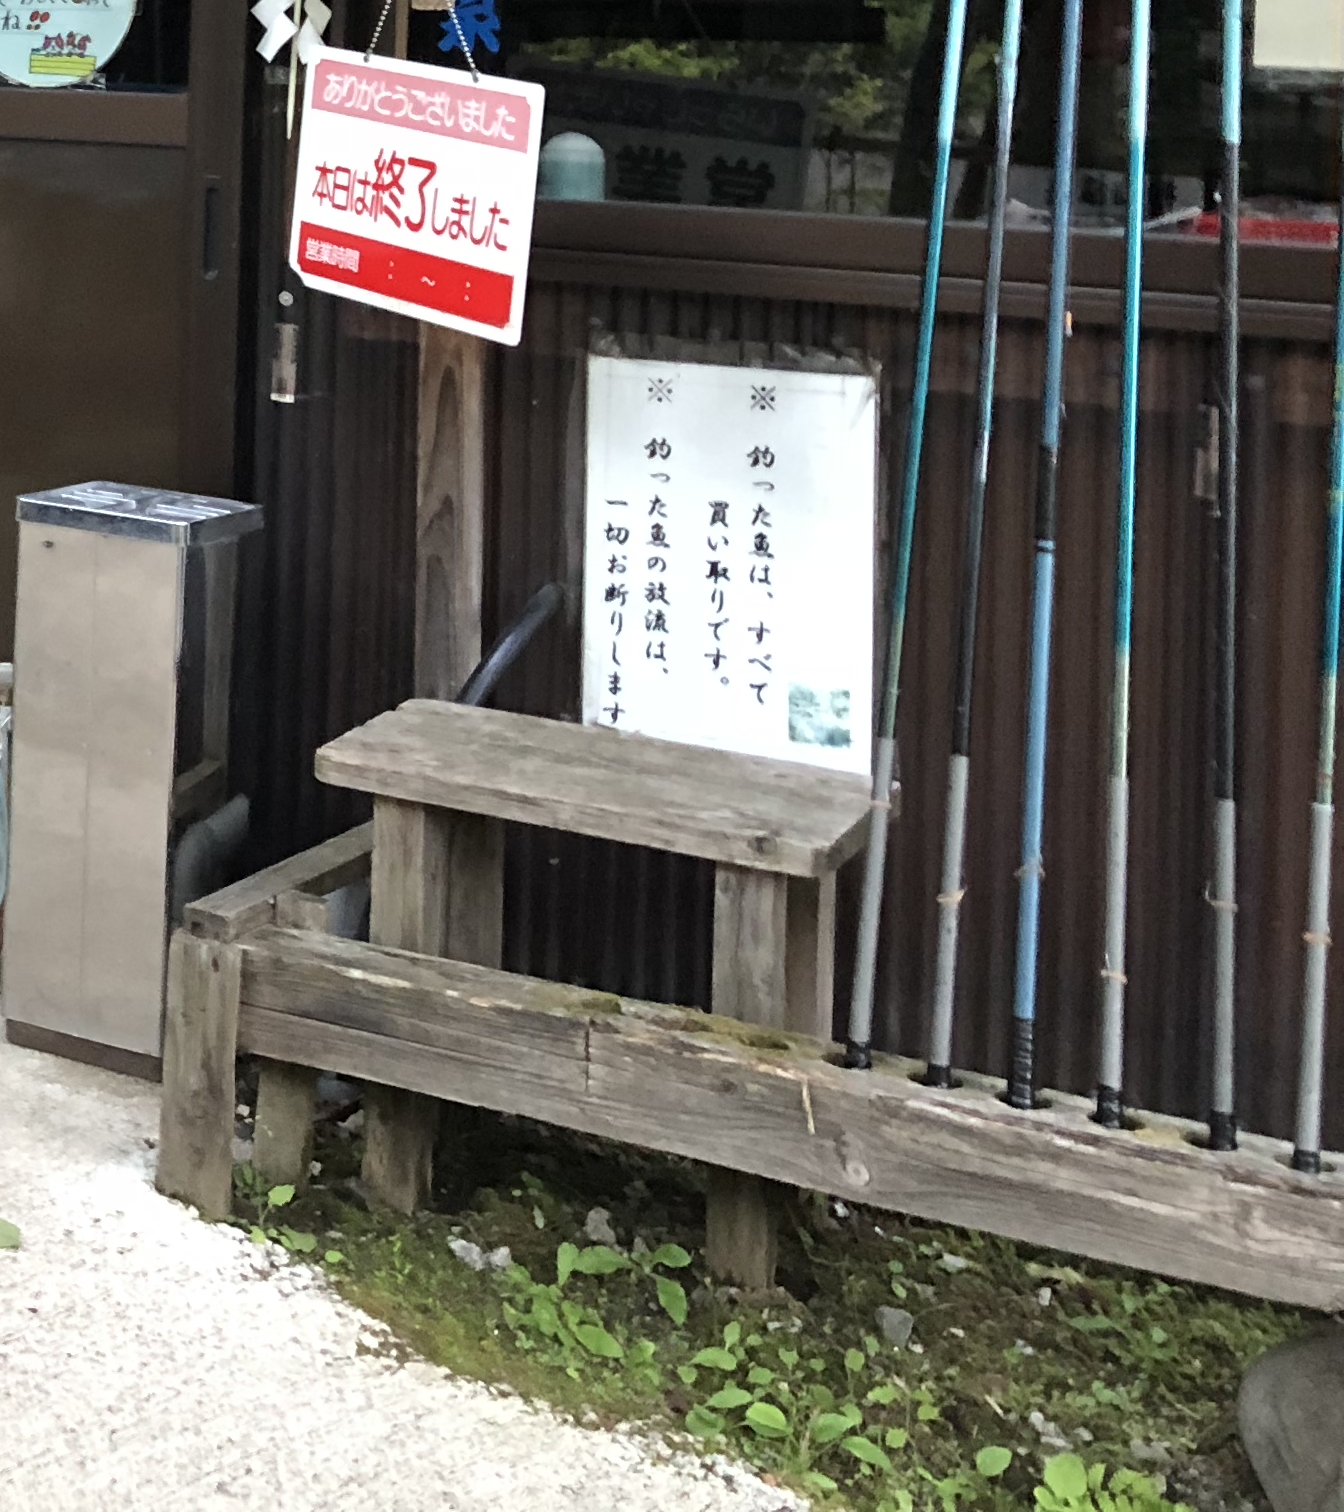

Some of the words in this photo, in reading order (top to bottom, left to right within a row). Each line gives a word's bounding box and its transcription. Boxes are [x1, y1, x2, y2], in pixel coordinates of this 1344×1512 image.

[323, 73, 517, 141] ありがとうございました
[305, 237, 360, 273] 営業時間
[312, 147, 510, 252] 本日は終了しました
[603, 499, 630, 725] 一切お断りします
[644, 436, 672, 677] 釣った魚の放流は、
[704, 499, 731, 688] 買い取りです。
